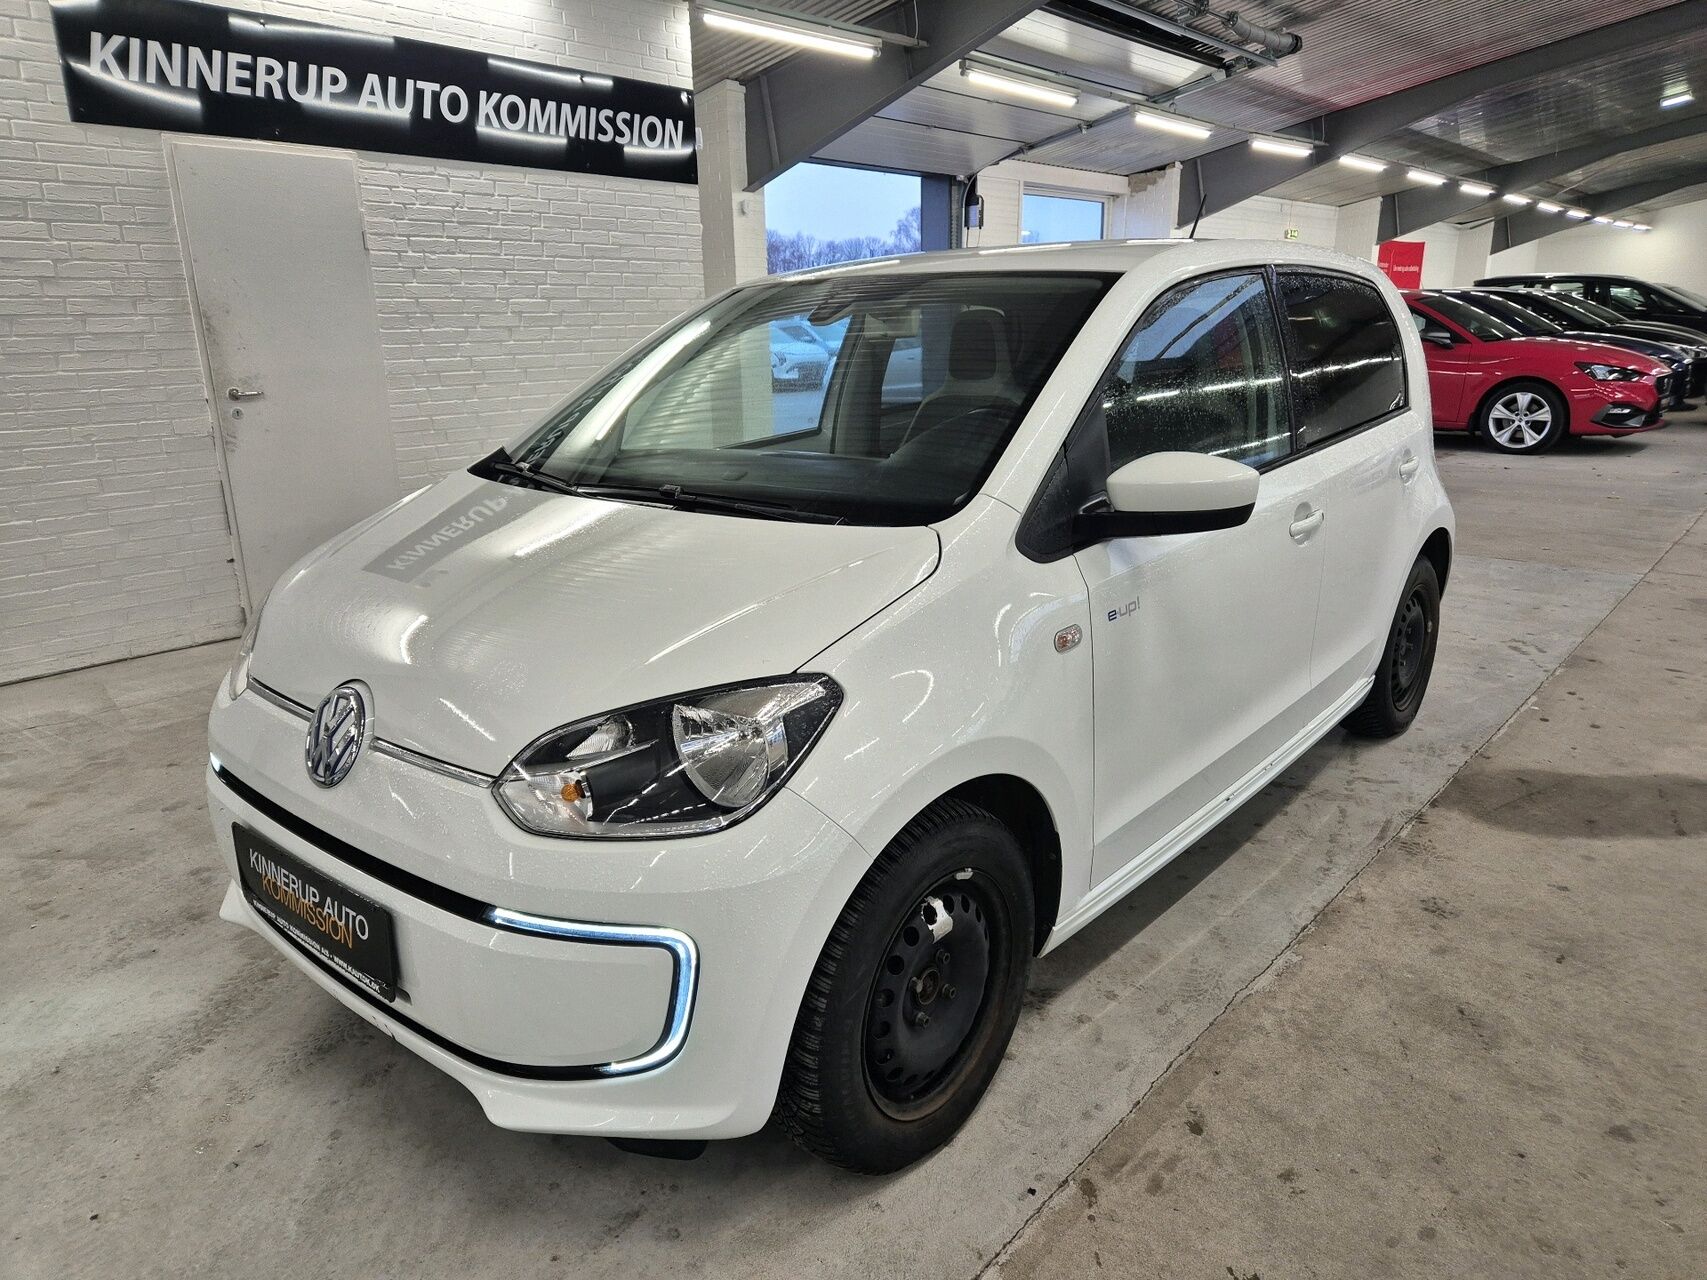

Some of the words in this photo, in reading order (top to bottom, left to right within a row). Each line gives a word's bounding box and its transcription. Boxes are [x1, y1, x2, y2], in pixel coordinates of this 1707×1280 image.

[90, 31, 348, 104] KINNERUP
[357, 73, 469, 123] AUTO
[478, 90, 684, 150] KOMMISSION
[249, 848, 320, 906] KINNERUP
[323, 896, 369, 940] AUTO
[262, 873, 353, 949] KOMMISSION
